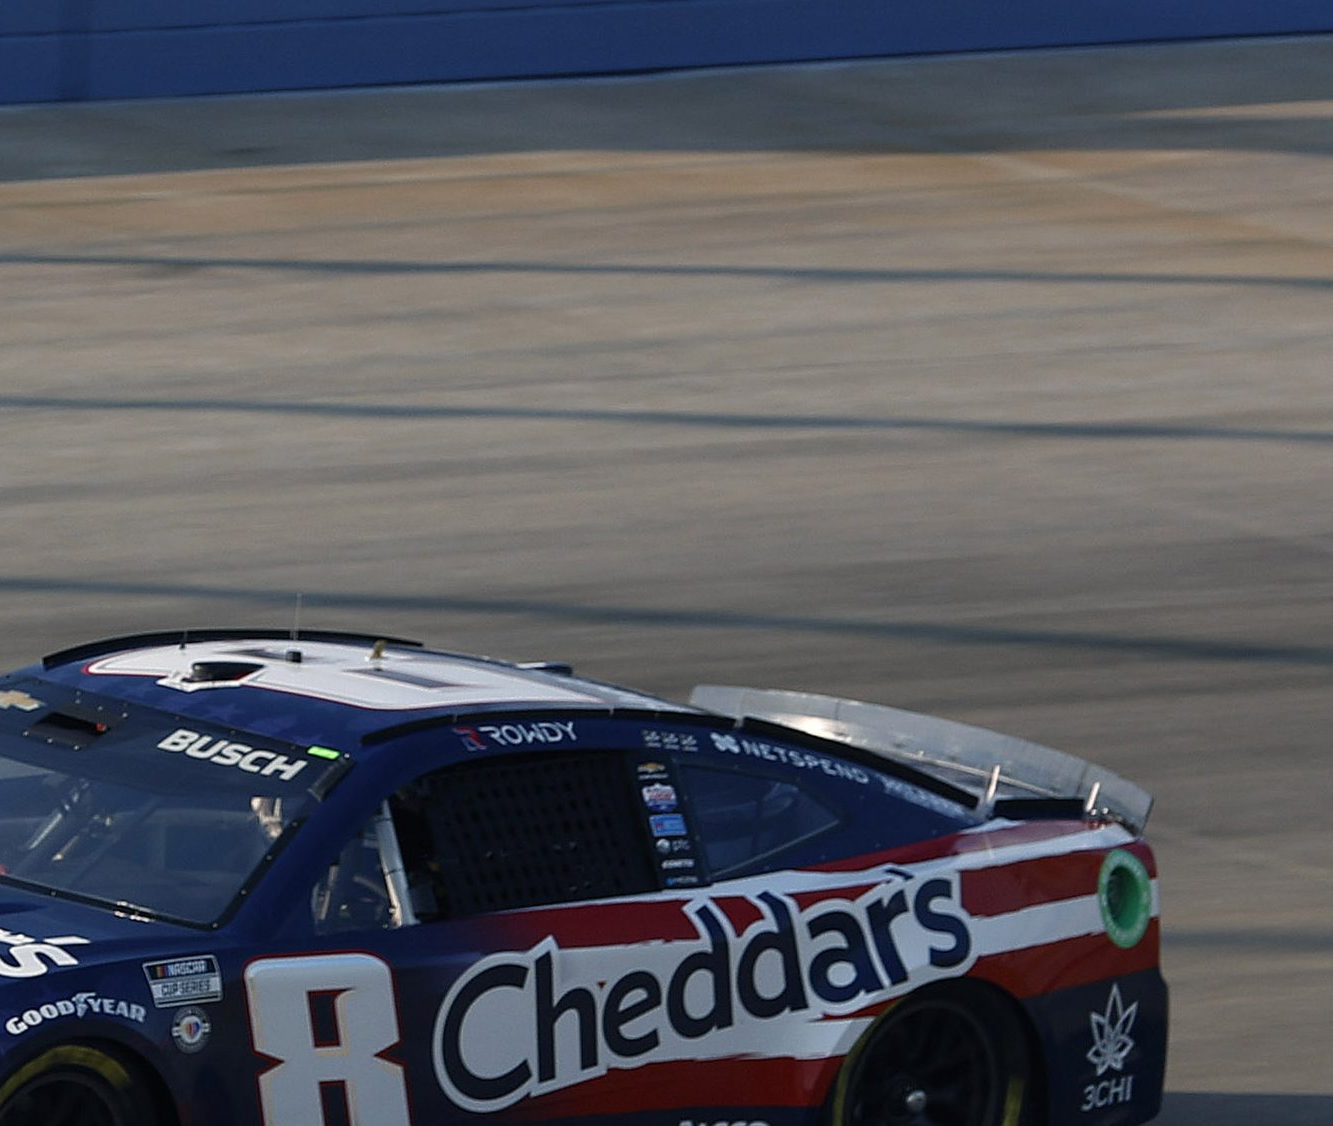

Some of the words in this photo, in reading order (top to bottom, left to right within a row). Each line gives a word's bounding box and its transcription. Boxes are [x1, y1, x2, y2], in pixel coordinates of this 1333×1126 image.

[157, 729, 307, 781] BUSCH
[480, 721, 577, 746] ROWDY
[741, 740, 869, 784] NETSPEND
[441, 869, 971, 1098] Cheddar's
[5, 992, 147, 1035] GOODYEAR
[1081, 1074, 1134, 1112] 3CHI
